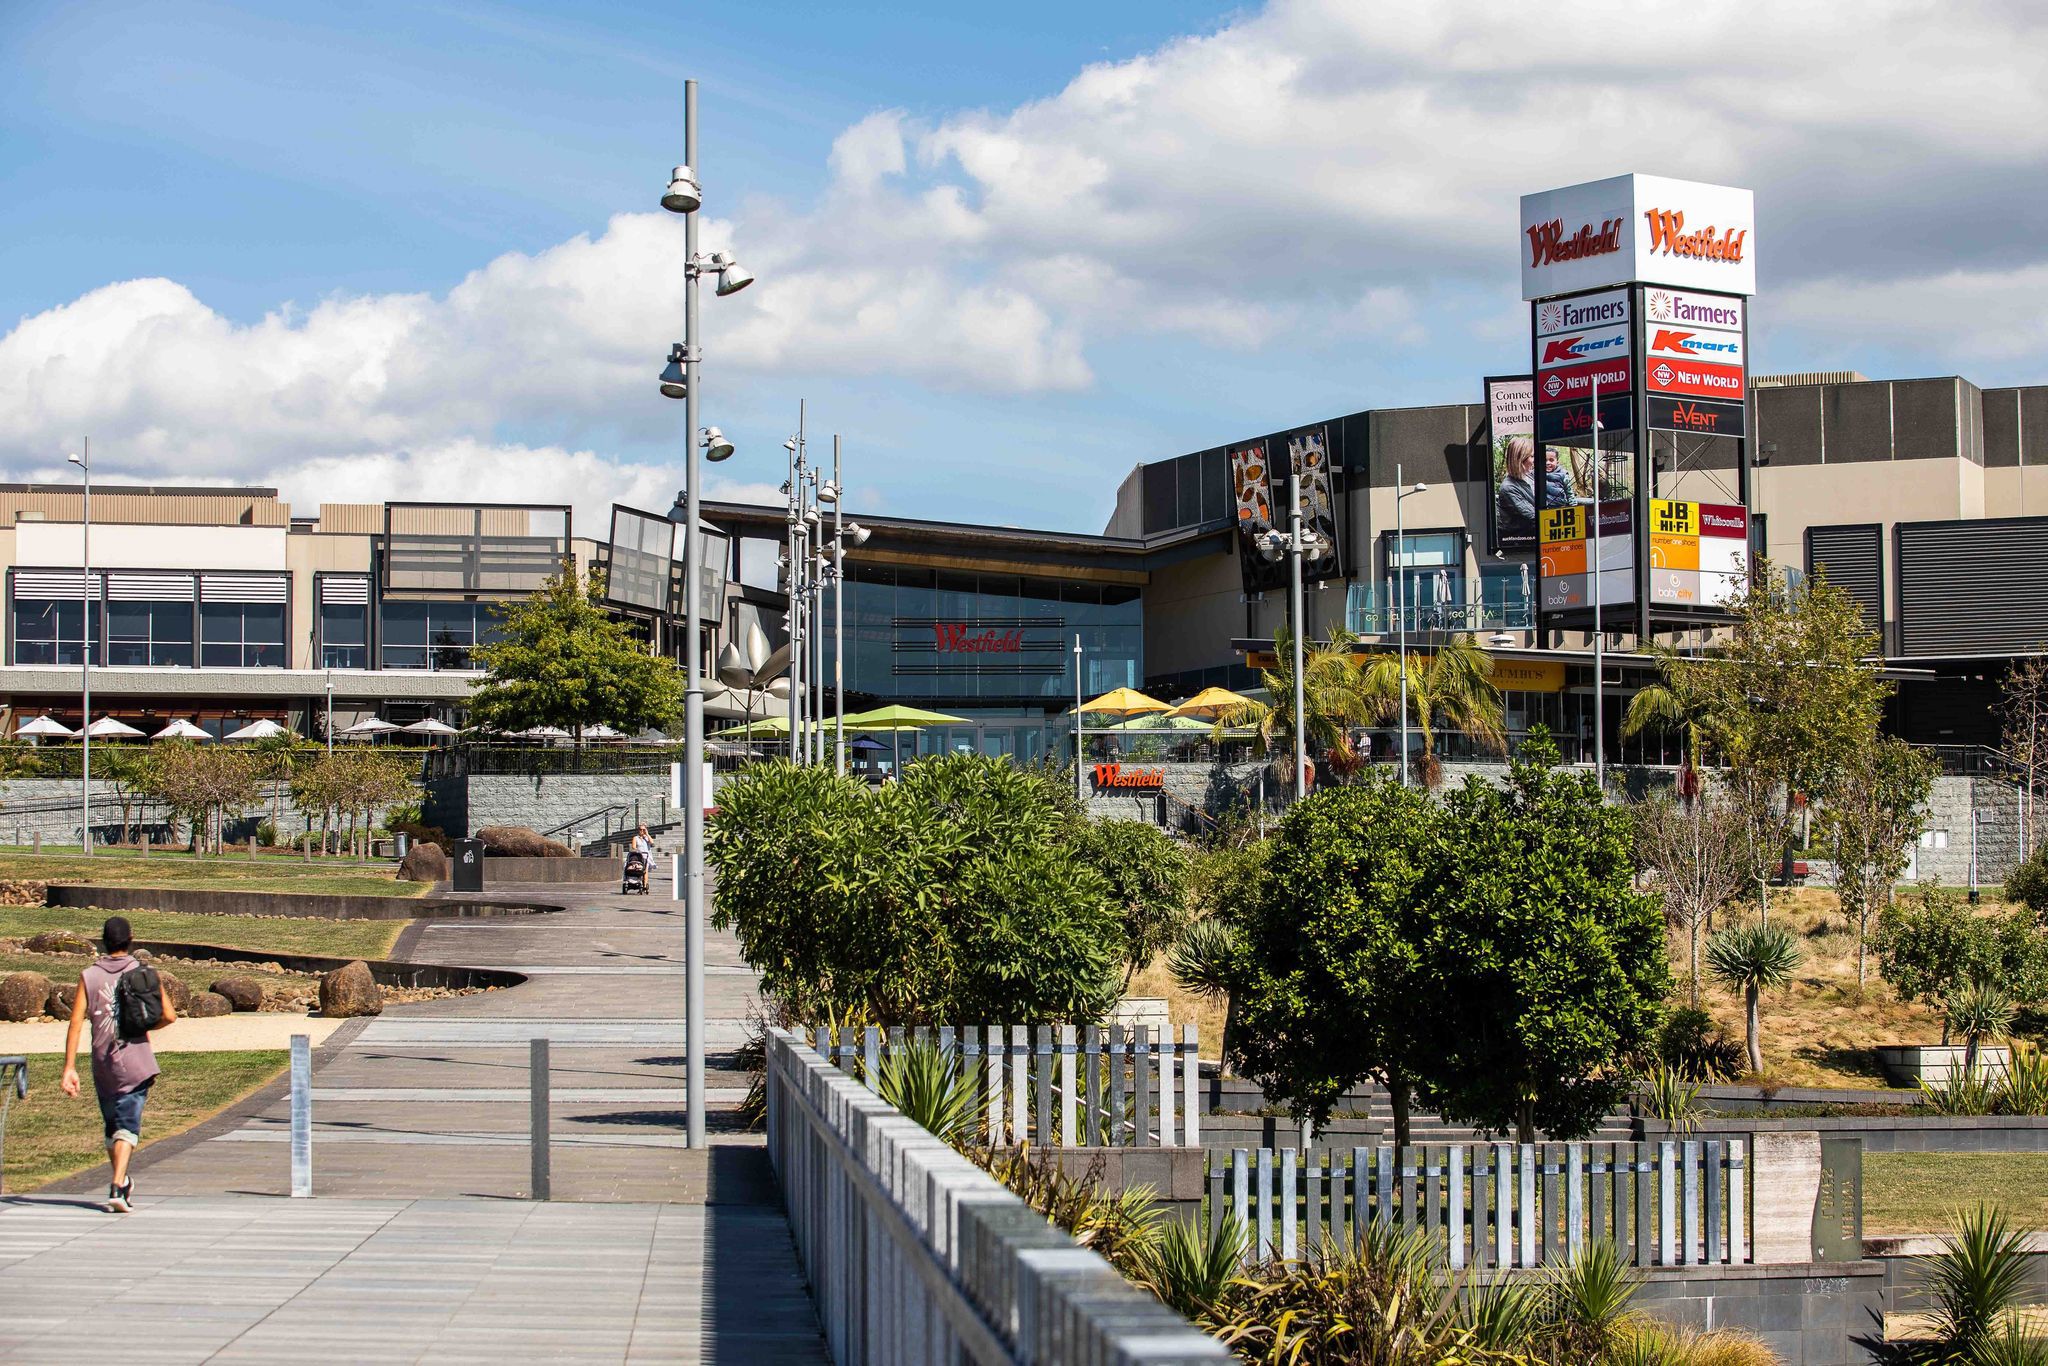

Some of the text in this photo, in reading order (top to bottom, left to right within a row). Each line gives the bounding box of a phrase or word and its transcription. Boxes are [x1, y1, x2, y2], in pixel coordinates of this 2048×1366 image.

[1526, 217, 1624, 268] Westfield
[1644, 207, 1747, 264] Westfield
[1563, 301, 1624, 326] Farmers
[1673, 296, 1738, 326] Farmers
[1542, 334, 1625, 364] Kmart
[1652, 329, 1738, 355] Kmart
[1547, 381, 1560, 389] NW
[1566, 370, 1626, 390] NEW WORLD
[1657, 371, 1670, 379] NW
[1677, 370, 1739, 388] NEW WORLD
[1495, 391, 1533, 401] Connec
[1496, 401, 1534, 411] with wil
[1497, 414, 1534, 425] togethe
[1673, 401, 1719, 426] EVENT
[1549, 508, 1576, 528] JB
[1660, 501, 1688, 520] JB
[1702, 514, 1744, 529] Whitcoulls
[933, 623, 1024, 653] Westfield
[1489, 668, 1544, 680] LUMBUS
[1093, 762, 1165, 788] Westfield
